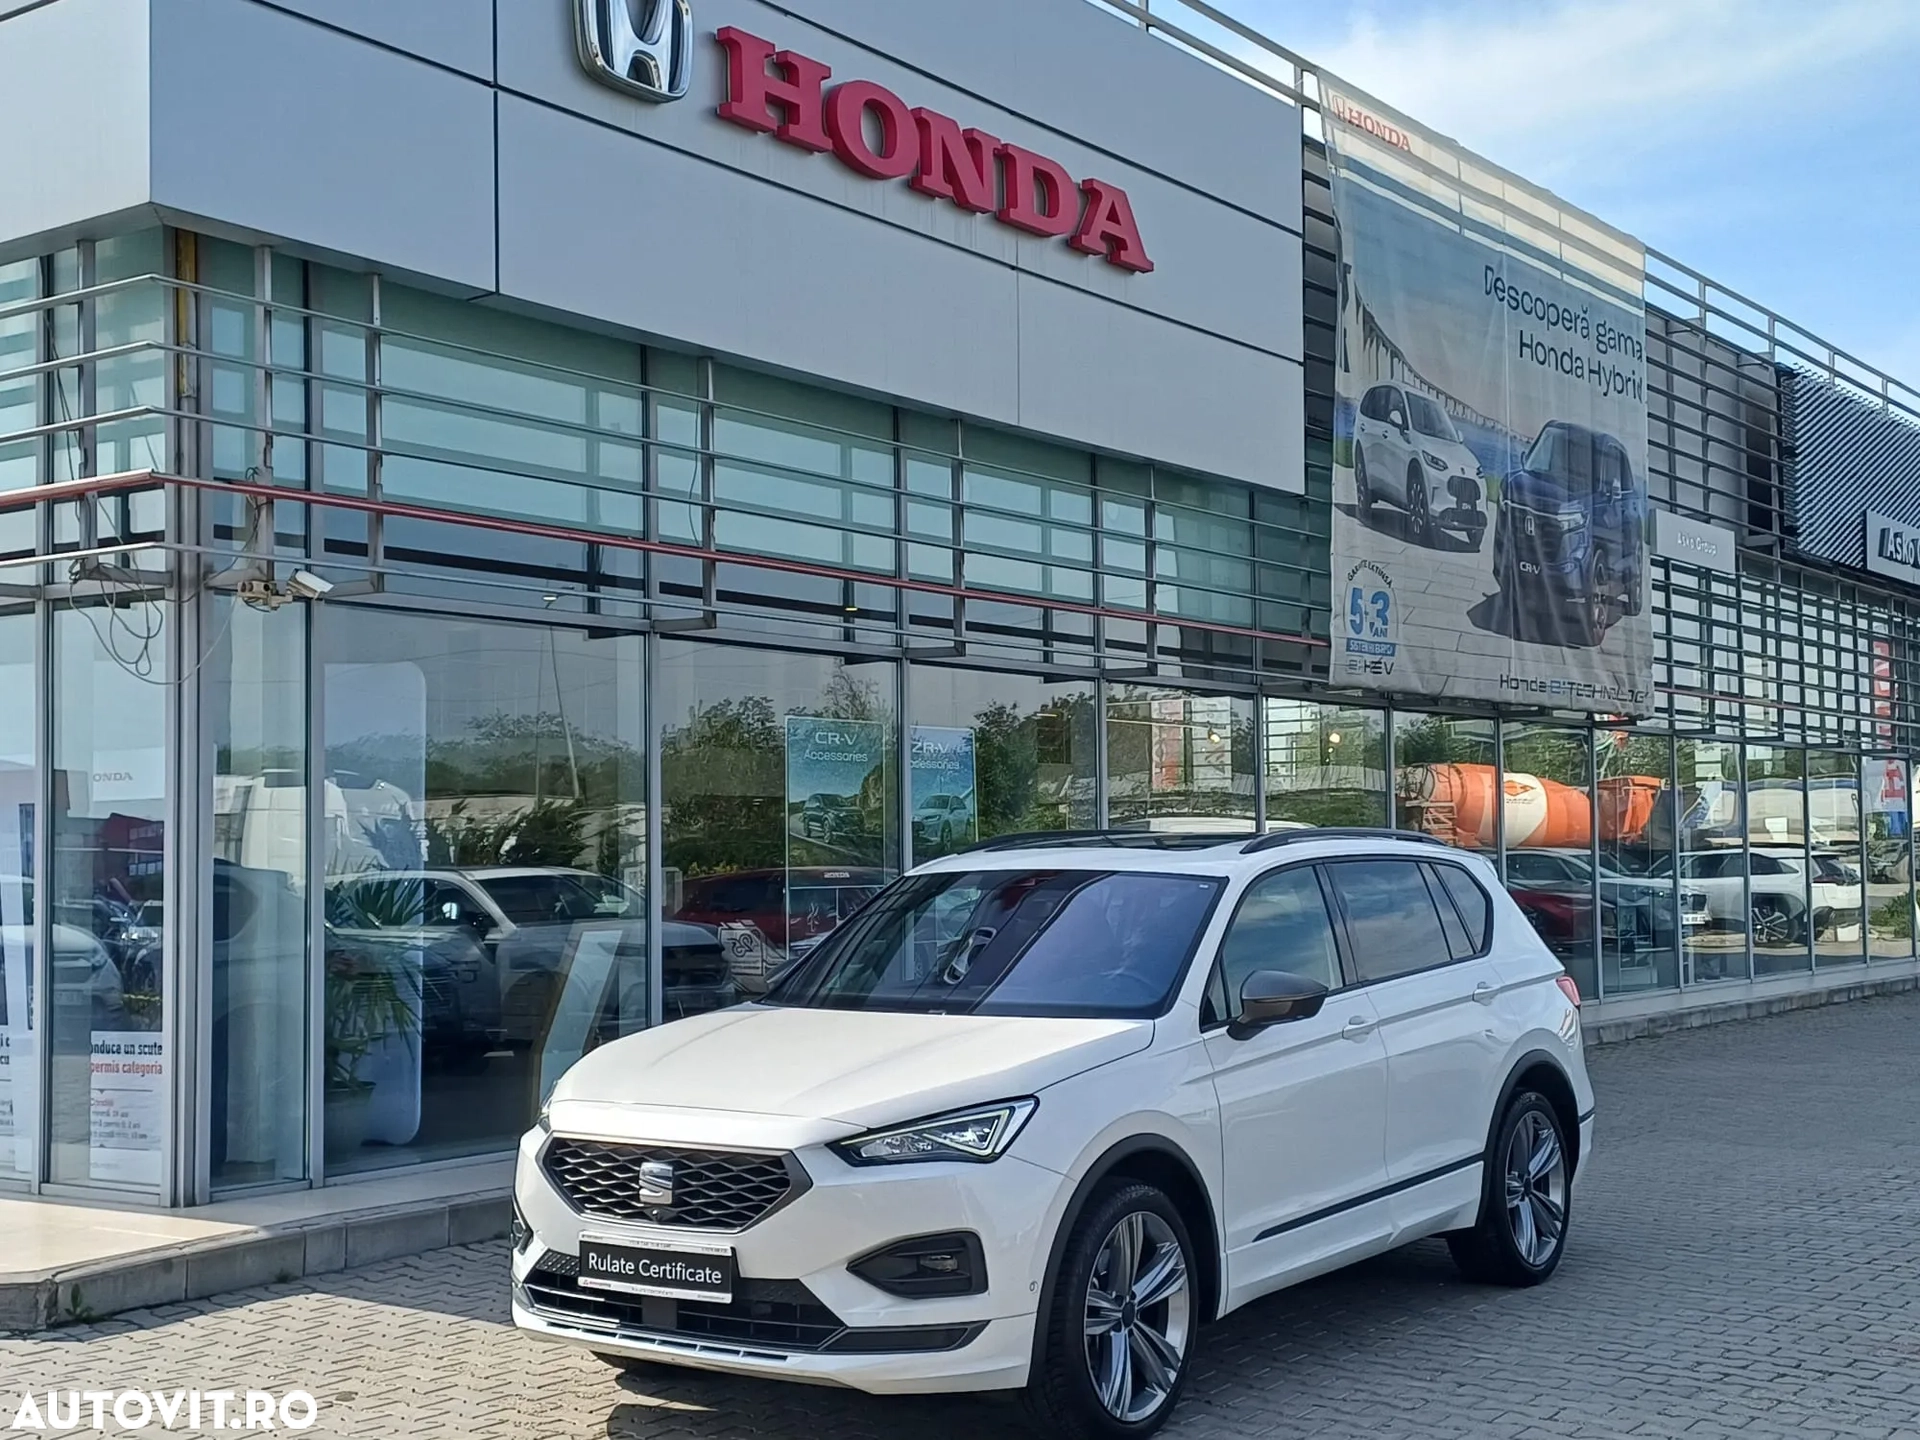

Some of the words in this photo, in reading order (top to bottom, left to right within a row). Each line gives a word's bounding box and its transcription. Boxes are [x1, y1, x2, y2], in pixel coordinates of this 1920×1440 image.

[1348, 107, 1413, 152] HONDA
[715, 26, 1154, 273] HONDA
[1519, 329, 1585, 381] Honda
[1520, 561, 1541, 575] CR-V
[815, 731, 858, 746] CR-V
[803, 750, 868, 763] Accessories
[93, 772, 133, 782] ONDA
[122, 1061, 162, 1077] categoria
[588, 1252, 635, 1275] Rulate
[638, 1259, 722, 1284] Certificate
